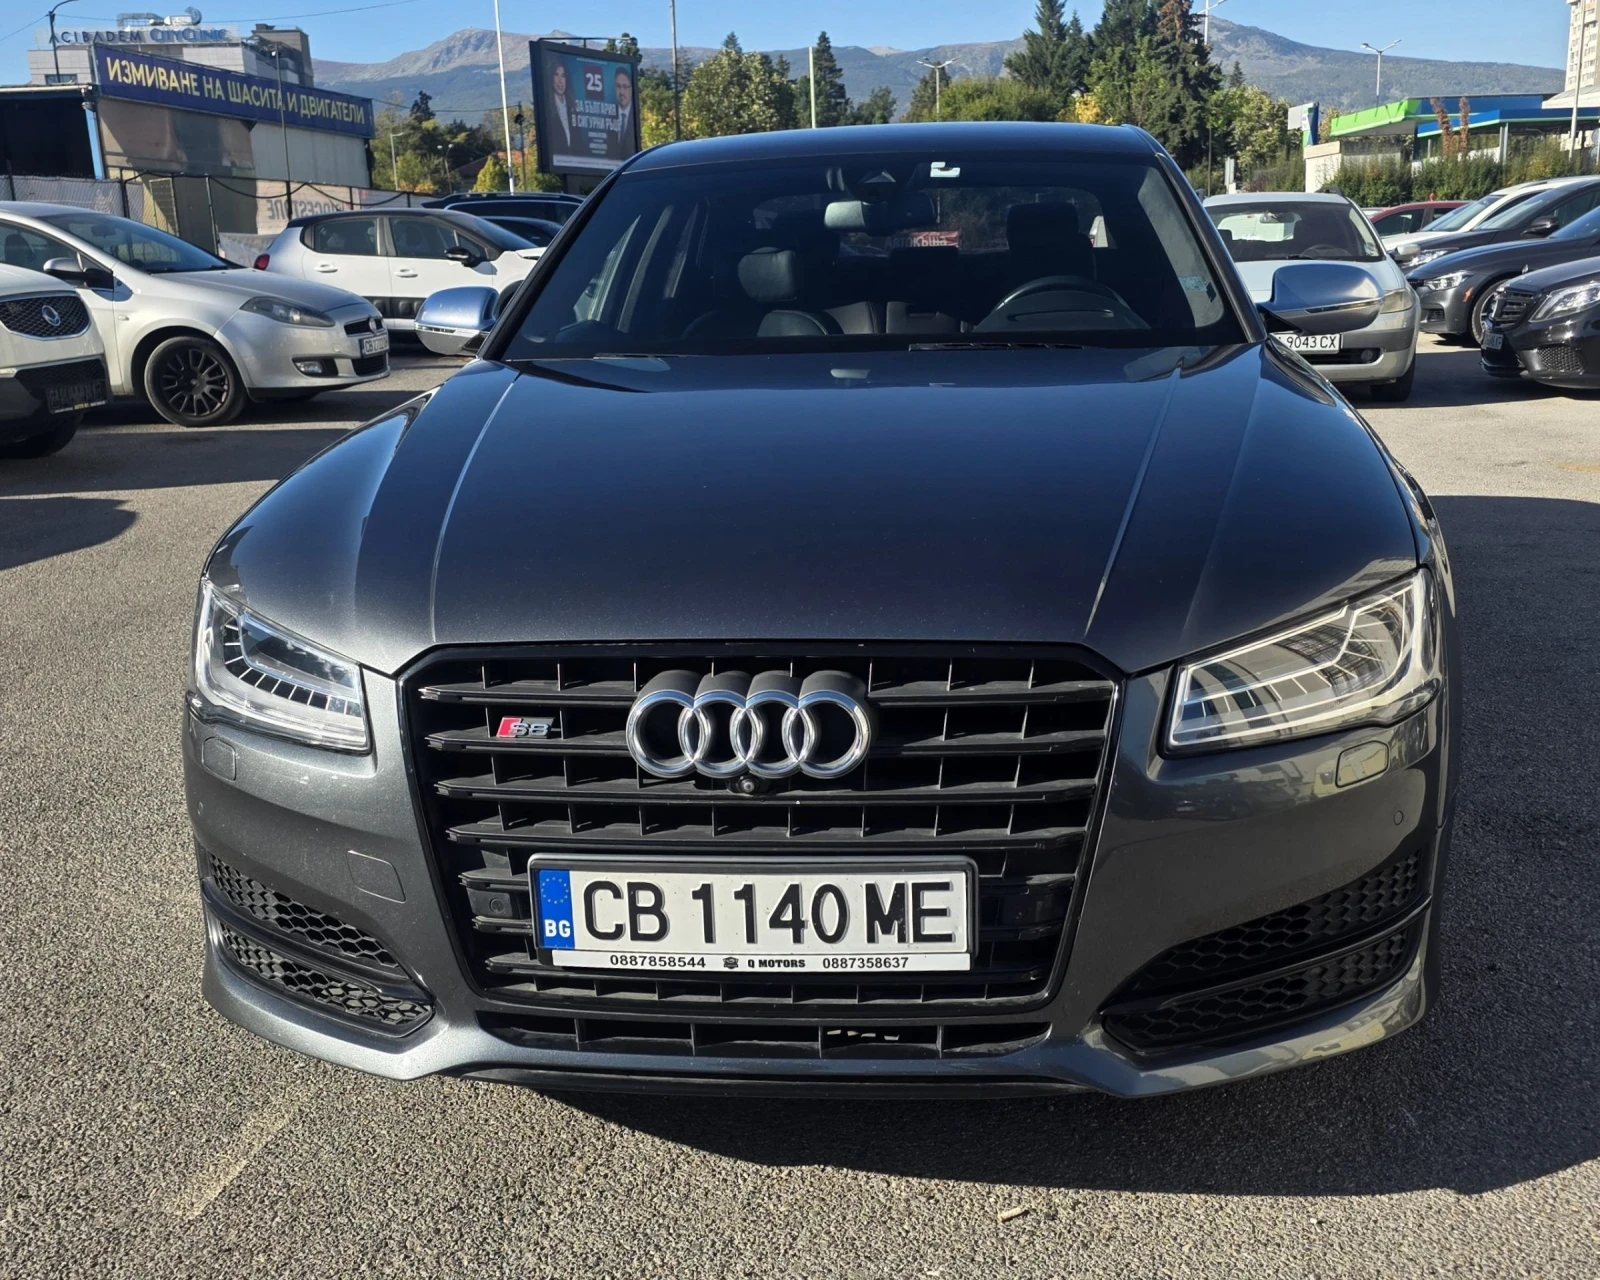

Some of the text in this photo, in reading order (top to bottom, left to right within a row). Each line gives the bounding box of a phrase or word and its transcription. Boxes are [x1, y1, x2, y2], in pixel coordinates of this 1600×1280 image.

[49, 31, 142, 43] ACIBADEM
[585, 73, 603, 91] 25
[106, 57, 365, 124] ИЗМИВАНЕ НА ШАСИТА И ДВИГАТЕЛИ
[1286, 336, 1337, 349] 9043 CX
[509, 722, 549, 736] S8
[544, 880, 955, 945] BG CB 1140 ME
[610, 954, 909, 969] 0887858544 Q MOTORS 0887358637
